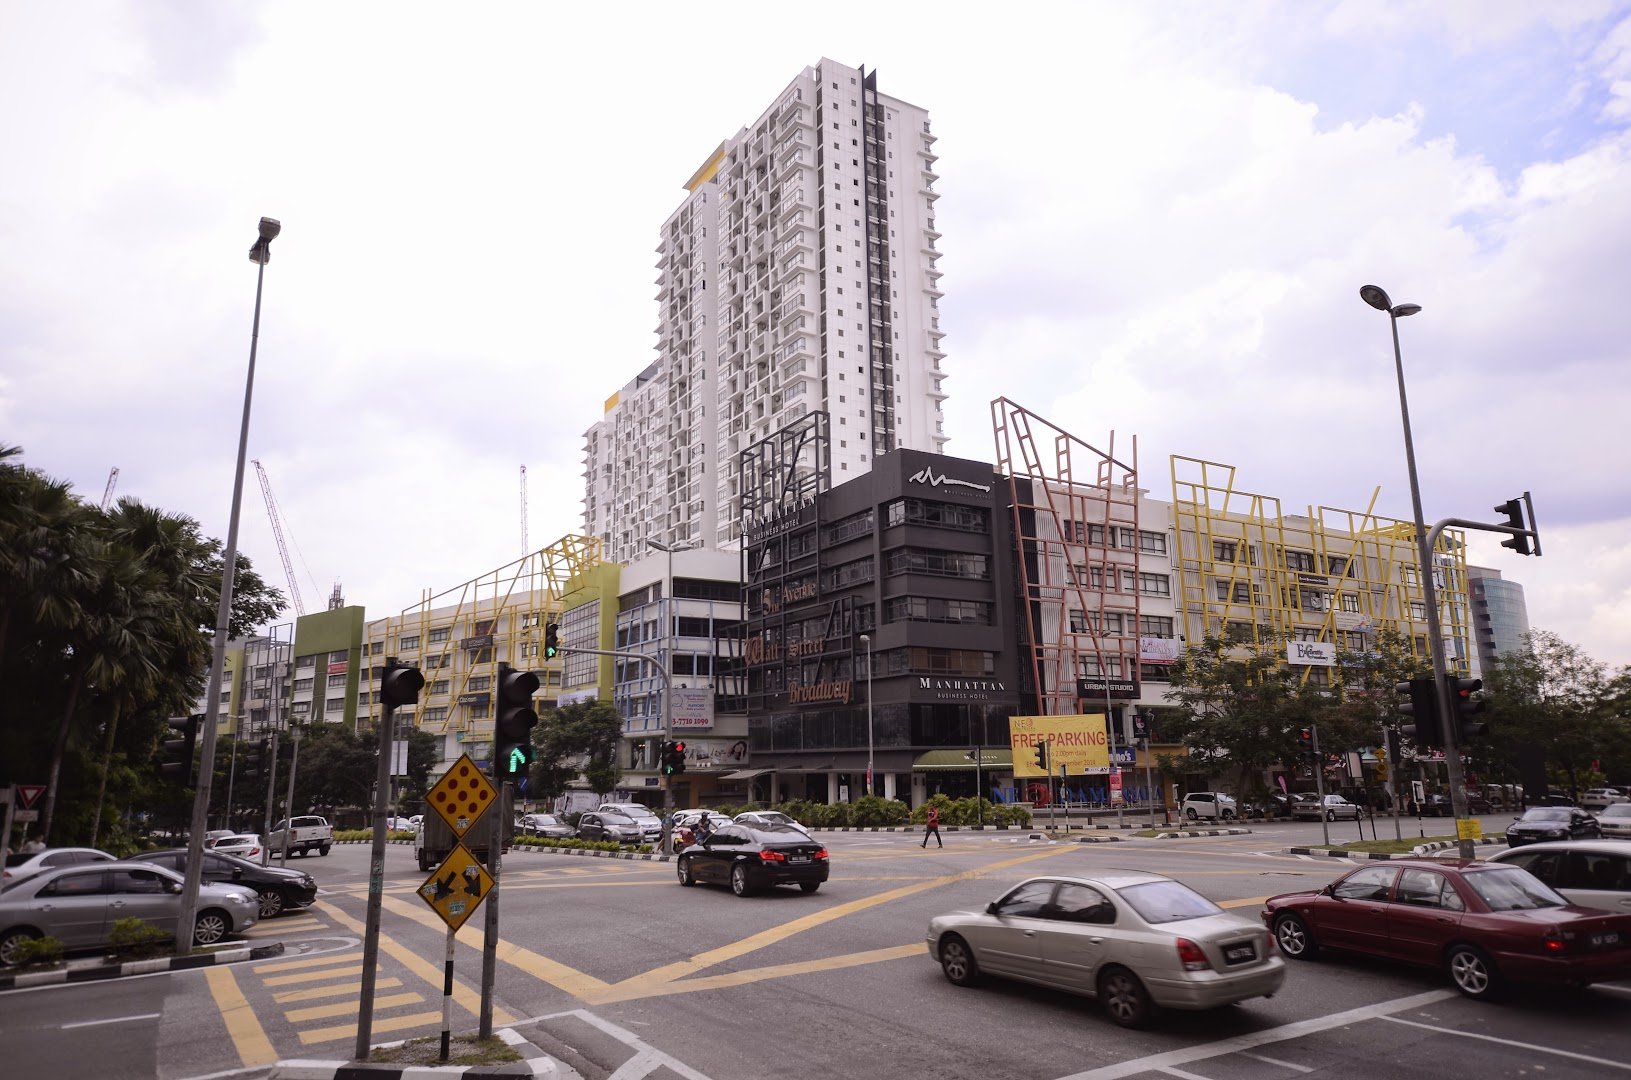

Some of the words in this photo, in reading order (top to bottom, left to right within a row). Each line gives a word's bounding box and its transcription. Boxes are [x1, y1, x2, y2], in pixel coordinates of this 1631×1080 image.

[740, 493, 817, 538] MANHATTAN
[753, 525, 779, 541] BUSINESS
[780, 518, 799, 530] HOTEL
[783, 582, 817, 604] Avenue
[788, 679, 852, 704] Broadway
[920, 677, 1005, 691] MANHATTAN
[1084, 683, 1108, 691] URBAN
[1109, 684, 1134, 692] STUDIO
[694, 718, 709, 726] 1090
[1048, 731, 1105, 747] PARKING
